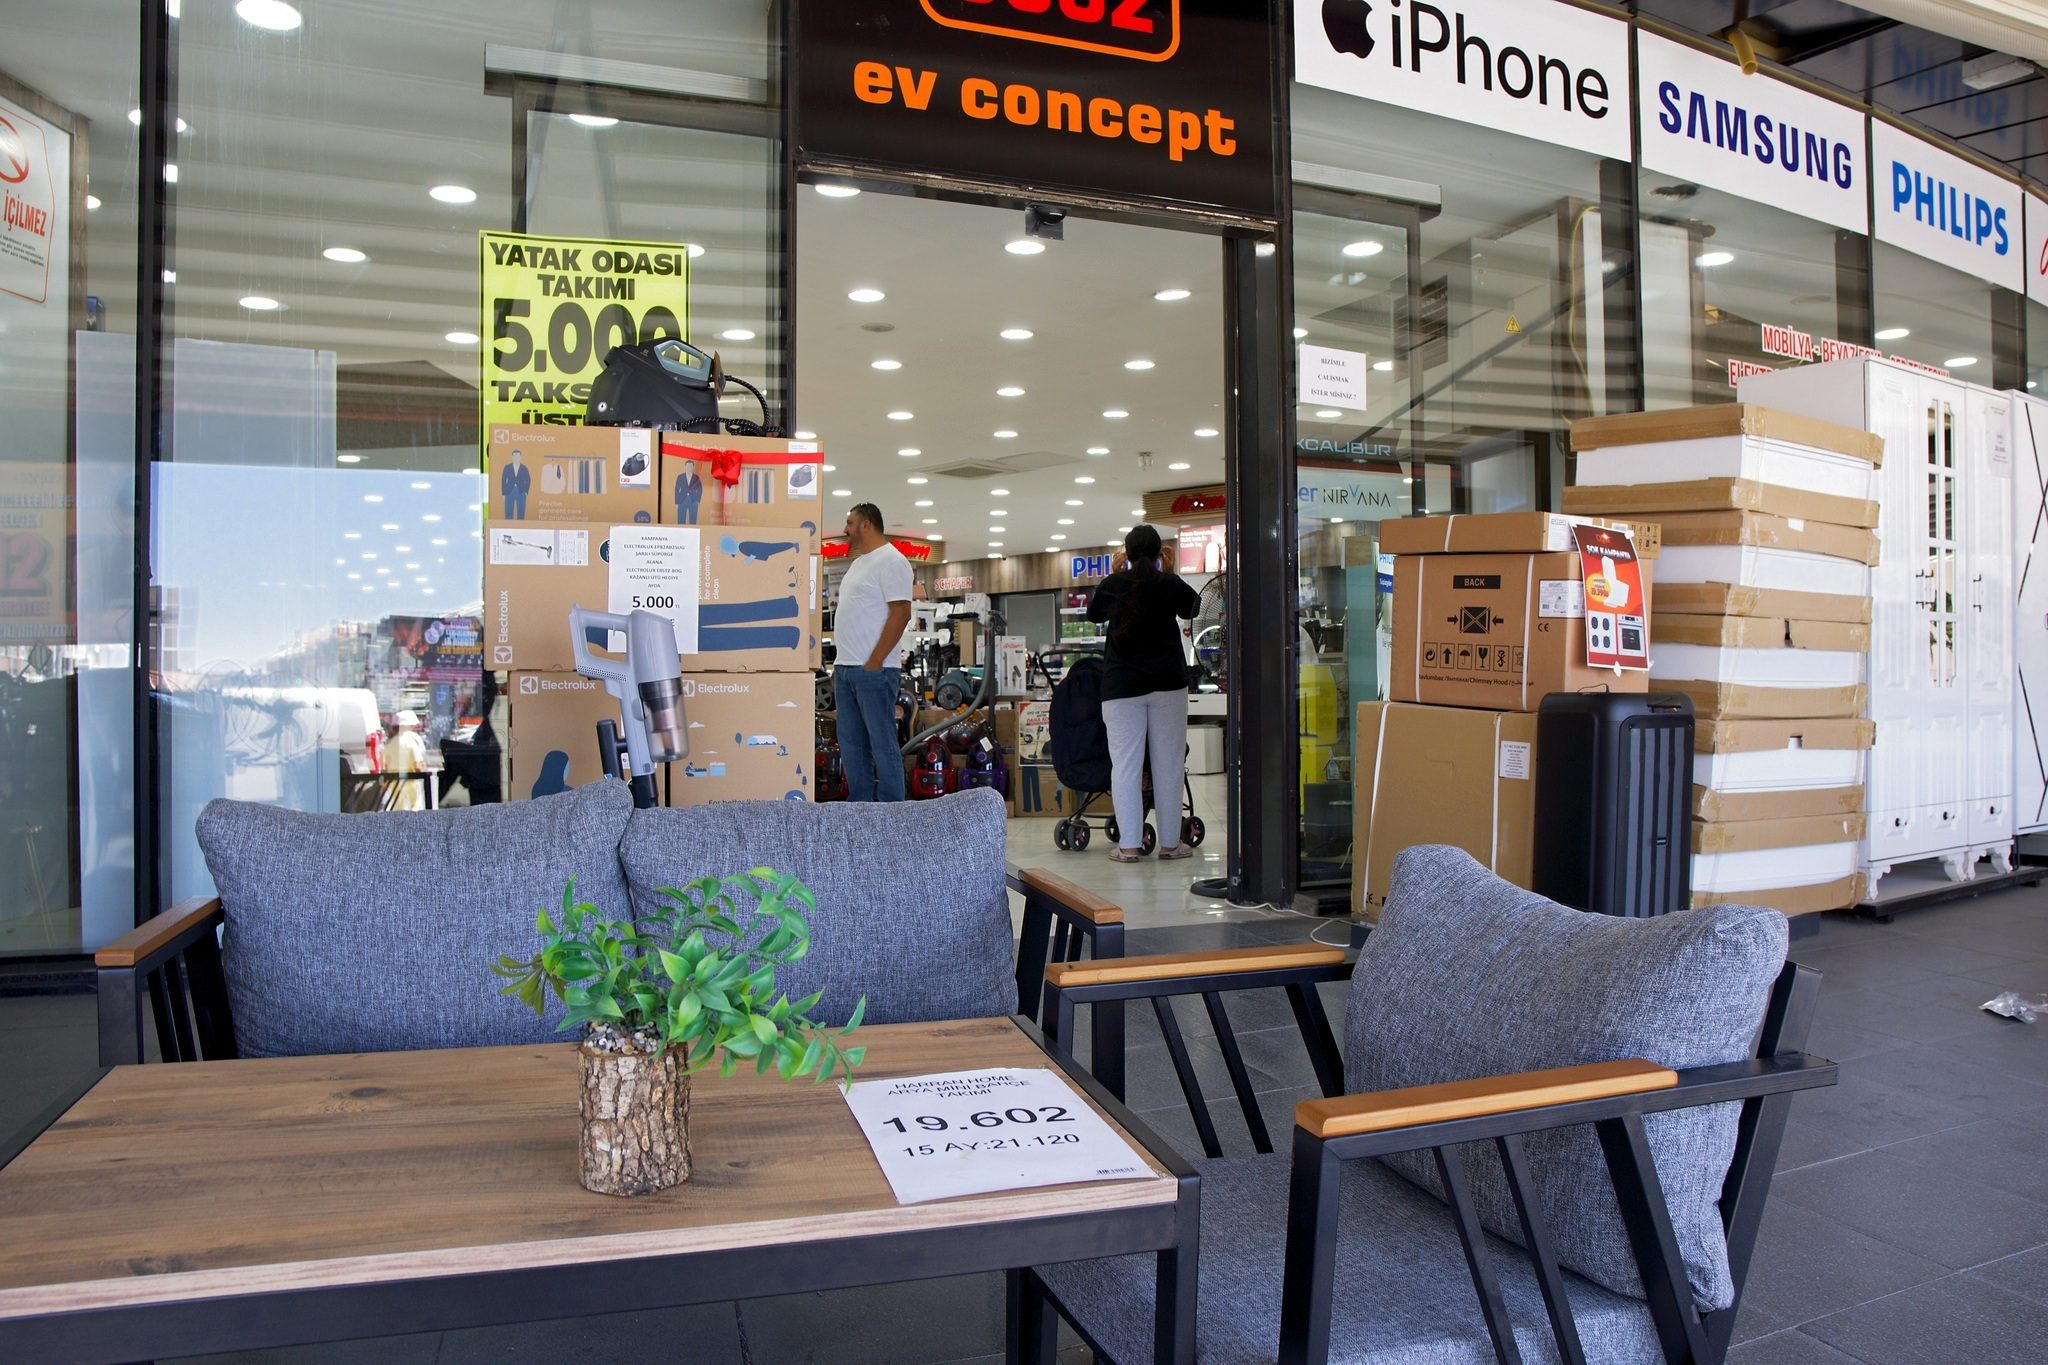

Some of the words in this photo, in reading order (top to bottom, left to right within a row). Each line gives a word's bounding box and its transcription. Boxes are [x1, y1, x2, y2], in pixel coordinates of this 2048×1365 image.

[1391, 0, 1609, 119] iPhone
[854, 61, 937, 110] ev
[961, 77, 1237, 162] concept
[1658, 81, 1852, 189] SAMSUNG
[3, 189, 47, 237] İÇİLMEZ
[1892, 160, 2009, 256] PHILIPS
[490, 242, 582, 271] YATAK
[592, 250, 682, 276] ODASI
[537, 274, 635, 300] TAKIMI
[1763, 326, 1813, 360] MOBİLYA
[491, 380, 591, 403] TAKS
[512, 432, 556, 443] Electrolux
[1297, 438, 1392, 456] XCALIBUR
[1323, 482, 1392, 508] NIRVANA
[1464, 578, 1485, 587] BACK
[632, 595, 674, 608] 5.000
[498, 590, 509, 643] Electrolux
[541, 679, 596, 690] Electrolux
[698, 682, 750, 694] Electrolux
[888, 1087, 934, 1096] ARYA
[895, 1078, 964, 1090] HARRAN
[967, 1074, 1017, 1084] HOME
[935, 1089, 992, 1098] TAKIMI
[883, 1106, 1076, 1133] 19.602
[903, 1144, 935, 1157] 15
